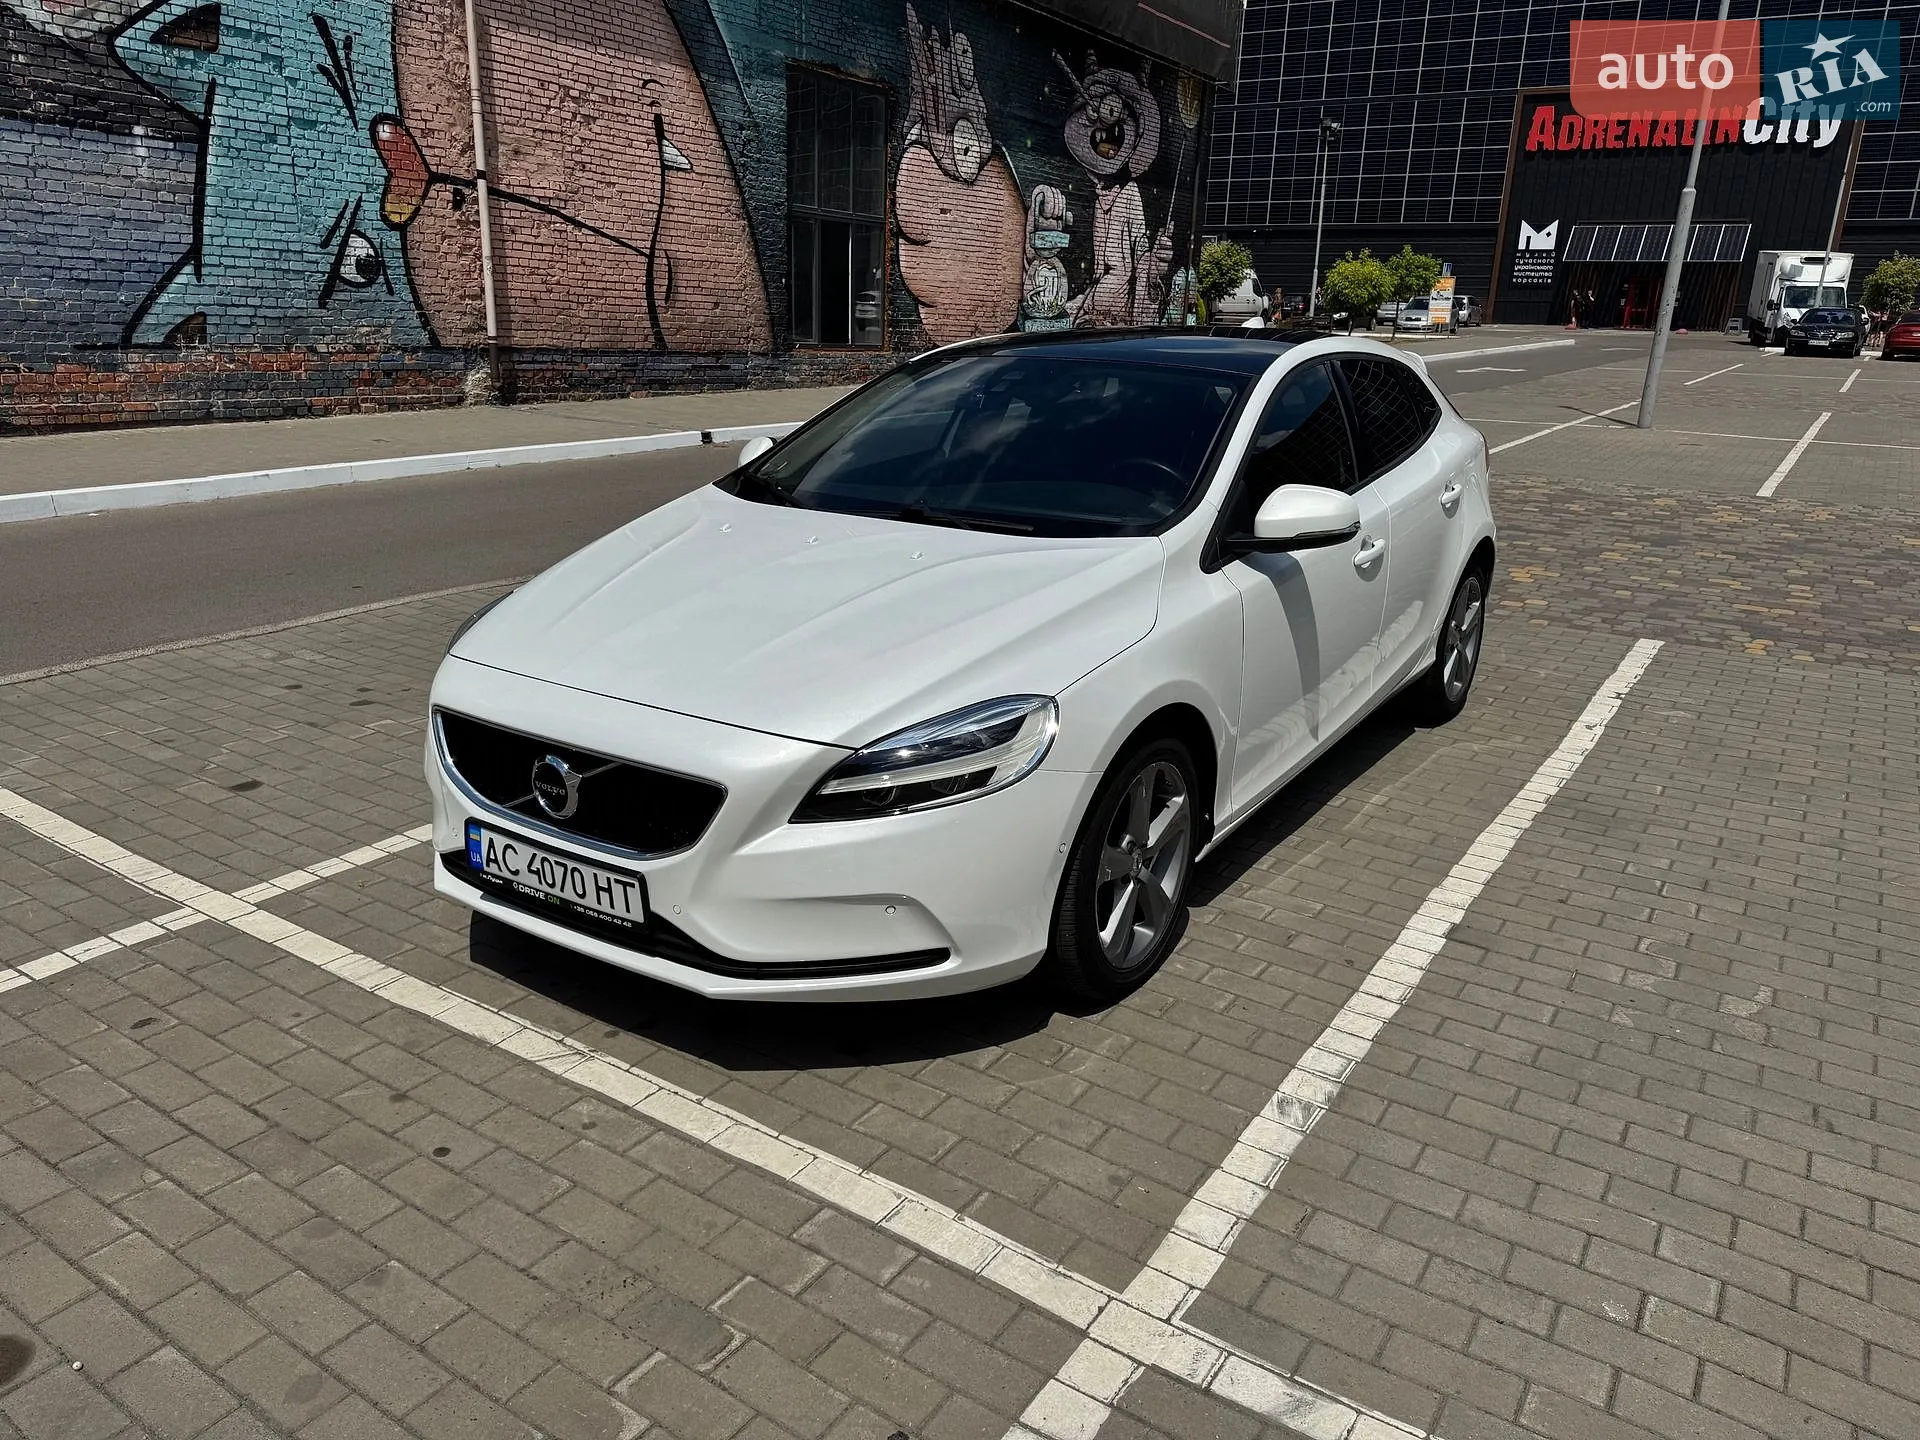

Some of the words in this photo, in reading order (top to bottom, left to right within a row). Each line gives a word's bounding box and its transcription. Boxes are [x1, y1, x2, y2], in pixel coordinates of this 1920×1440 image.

[535, 780, 566, 796] VOLVO
[470, 850, 482, 864] UA
[485, 837, 520, 877] AC
[526, 852, 587, 900] 4070
[593, 872, 636, 914] HT
[518, 885, 546, 901] DRIVE
[547, 895, 560, 905] ON
